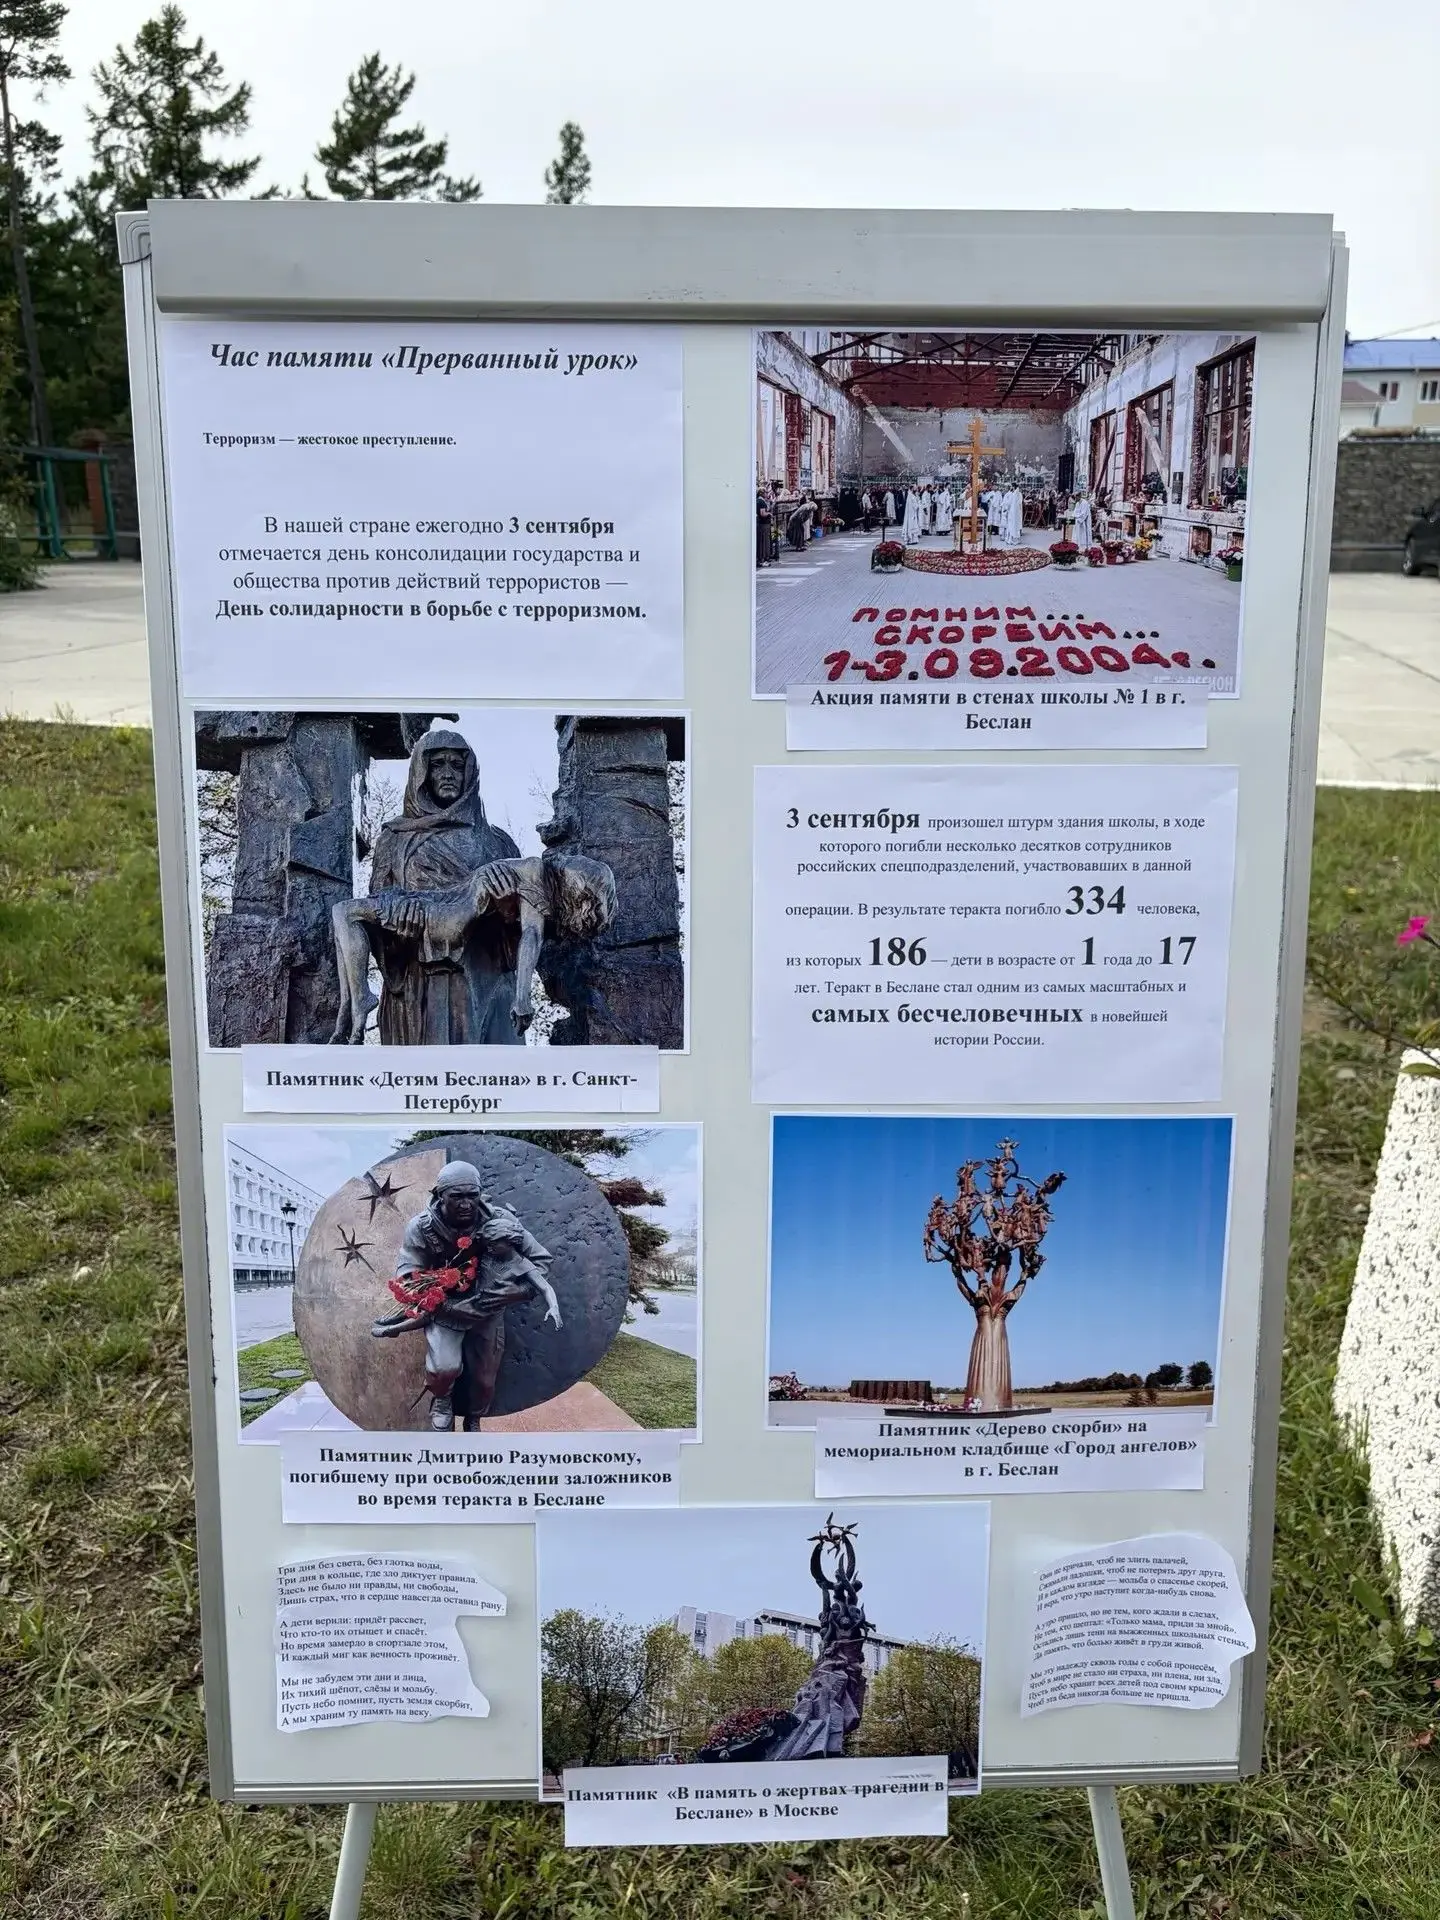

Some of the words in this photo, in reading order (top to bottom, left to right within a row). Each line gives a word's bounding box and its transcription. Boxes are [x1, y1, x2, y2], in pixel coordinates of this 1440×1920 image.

[211, 343, 260, 368] Час
[266, 351, 373, 369] памяти
[381, 345, 560, 376] «Прерванный
[563, 353, 639, 376] урок»
[202, 432, 276, 448] Терроризм
[297, 435, 360, 446] жестокое
[362, 435, 457, 449] преступление.
[263, 516, 279, 534] В
[283, 516, 345, 534] нашей
[348, 520, 411, 538] стране
[415, 520, 504, 537] ежегодно
[508, 516, 520, 534] 3
[525, 516, 615, 539] сентября
[218, 547, 322, 562] отмечается
[326, 548, 371, 564] день
[374, 547, 508, 565] консолидации
[512, 547, 624, 568] государства
[629, 550, 641, 563] и
[233, 571, 322, 593] общества
[325, 575, 391, 594] против
[395, 572, 481, 592] действий
[485, 576, 601, 595] террористов
[215, 599, 265, 621] День
[269, 603, 404, 621] солидарности
[409, 604, 422, 617] в
[426, 599, 493, 622] борьбе
[497, 604, 509, 617] с
[512, 604, 647, 623] терроризмом.
[810, 689, 874, 708] Акция
[879, 692, 951, 705] памяти
[956, 692, 968, 705] в
[972, 692, 1035, 705] стенах
[1040, 692, 1109, 705] школы
[1112, 688, 1136, 705] №
[1140, 688, 1149, 705] 1
[1155, 692, 1167, 705] в
[1171, 692, 1186, 705] г.
[965, 713, 1032, 730] Беслан
[786, 807, 800, 829] 3
[807, 807, 921, 832] сентября
[927, 818, 1005, 832] произошел
[1007, 818, 1054, 832] штурм
[1056, 818, 1105, 831] здания
[1107, 818, 1159, 832] школы,
[1162, 818, 1171, 828] в
[1173, 817, 1206, 830] ходе
[818, 841, 882, 856] которого
[884, 839, 943, 853] погибли
[945, 841, 1017, 853] несколько
[1019, 841, 1083, 856] десятков
[1084, 840, 1173, 856] сотрудников
[797, 859, 877, 876] российских
[880, 859, 1020, 876] спецподразделений,
[1022, 861, 1129, 876] участвовавших
[1131, 861, 1140, 872] в
[1142, 858, 1192, 873] данной
[785, 905, 854, 919] операции.
[857, 902, 869, 916] В
[871, 905, 947, 919] результате
[948, 905, 1002, 919] теракта
[1005, 902, 1062, 916] погибло
[1064, 886, 1127, 916] 334
[1136, 904, 1201, 917] человека,
[786, 956, 802, 967] из
[804, 956, 863, 970] которых
[868, 936, 928, 967] 186
[950, 956, 983, 968] дети
[986, 956, 995, 966] в
[997, 956, 1057, 970] возрасте
[1059, 956, 1076, 967] от
[1081, 936, 1097, 966] 1
[1103, 956, 1134, 968] года
[1135, 955, 1153, 967] до
[1157, 935, 1198, 966] 17
[794, 983, 821, 994] лет.
[823, 980, 872, 997] Теракт
[874, 983, 883, 994] в
[886, 980, 941, 994] Беслане
[943, 983, 973, 993] стал
[976, 983, 1021, 995] одним
[1023, 983, 1040, 994] из
[1042, 983, 1086, 993] самых
[1089, 979, 1175, 993] масштабных
[1177, 982, 1187, 992] и
[811, 1007, 891, 1024] самых
[897, 1002, 1084, 1024] бесчеловечных
[1090, 1011, 1099, 1022] в
[1101, 1009, 1168, 1023] новейшей
[934, 1035, 990, 1049] истории
[993, 1033, 1045, 1046] России.
[265, 1070, 365, 1087] Памятник
[369, 1071, 439, 1091] «Детям
[443, 1071, 531, 1087] Беслана»
[536, 1075, 547, 1087] в
[552, 1075, 567, 1087] г.
[571, 1070, 638, 1087] Санкт-
[403, 1093, 503, 1114] Петербург
[878, 1423, 972, 1437] Памятник
[975, 1421, 1047, 1439] «Дерево
[1051, 1419, 1123, 1438] скорби»
[1127, 1421, 1148, 1433] на
[319, 1447, 413, 1463] Памятник
[416, 1449, 504, 1468] Дмитрию
[507, 1450, 642, 1468] Разумовскому,
[824, 1445, 957, 1461] мемориальном
[961, 1441, 1050, 1458] кладбище
[1053, 1440, 1116, 1457] «Город
[1120, 1440, 1198, 1454] ангелов»
[289, 1469, 390, 1488] погибшему
[394, 1472, 429, 1489] при
[432, 1469, 560, 1488] освобождении
[563, 1472, 673, 1486] заложников
[964, 1466, 975, 1478] в
[979, 1466, 993, 1477] г.
[997, 1462, 1059, 1477] Беслан
[357, 1494, 378, 1506] во
[382, 1494, 437, 1509] время
[441, 1495, 513, 1509] теракта
[517, 1495, 528, 1507] в
[532, 1491, 606, 1507] Беслане
[567, 1789, 658, 1802] Памятник
[666, 1786, 690, 1800] «В
[694, 1788, 758, 1800] память
[762, 1787, 772, 1798] о
[776, 1784, 847, 1802] жертвах
[853, 1781, 930, 1798] трагедии
[934, 1781, 945, 1792] в
[675, 1806, 754, 1821] Беслане»
[758, 1807, 769, 1818] в
[773, 1803, 839, 1818] Москве
